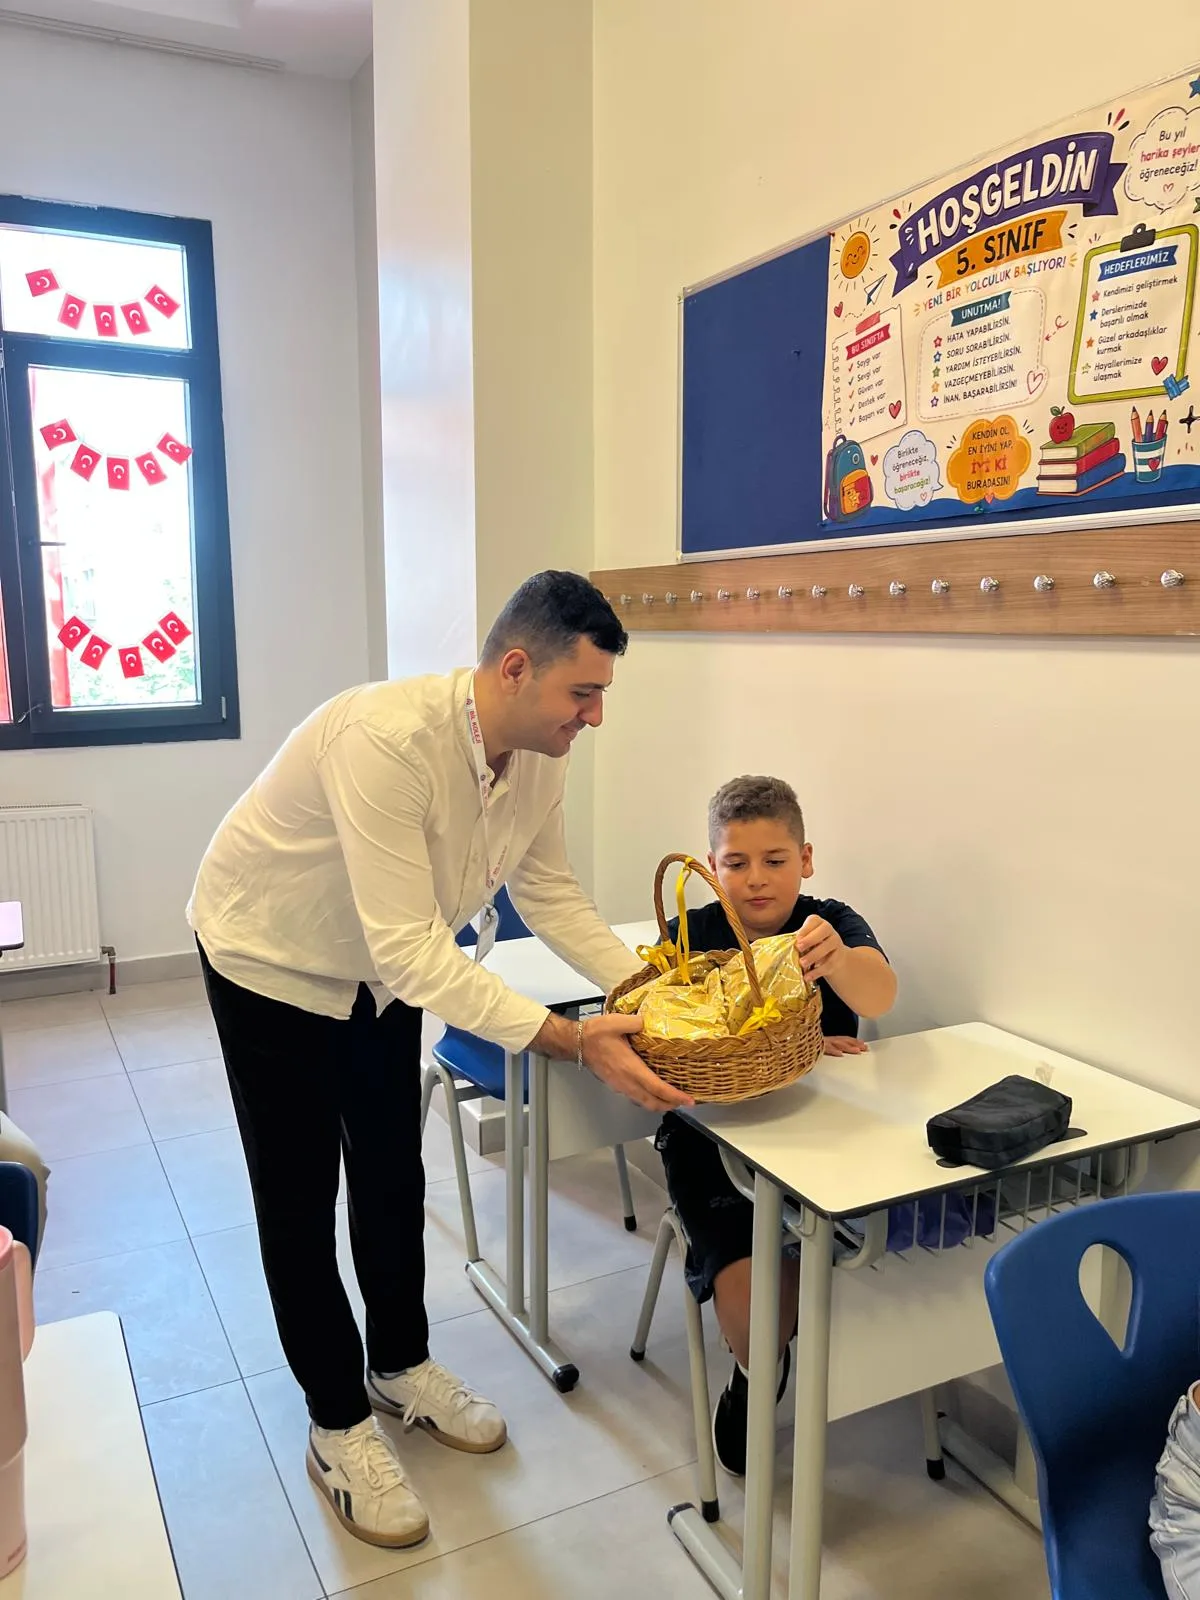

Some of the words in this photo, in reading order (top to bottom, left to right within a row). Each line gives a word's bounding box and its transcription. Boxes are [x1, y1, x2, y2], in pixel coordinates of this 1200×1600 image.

[1159, 130, 1171, 141] Bu
[1175, 126, 1187, 142] yıl
[1141, 148, 1169, 163] harika
[1172, 143, 1200, 158] şeyler
[1140, 159, 1198, 182] öğreneceğiz!
[917, 141, 1098, 254] HOŞGELDİN
[957, 247, 976, 275] 5.
[984, 218, 1047, 264] SINIF
[1104, 251, 1169, 275] HEDEFLERİMİZ
[922, 293, 943, 311] YENİ
[946, 286, 961, 302] BİR
[965, 268, 1011, 293] YOLCULUK
[1013, 256, 1067, 277] BAŞLIYOR!
[1103, 283, 1135, 297] Kendimizi
[1136, 275, 1178, 293] geliştirmek
[961, 299, 1001, 319] UNUTMA!
[1101, 300, 1147, 317] Derslerimizde
[1100, 315, 1124, 328] başarılı
[1127, 311, 1149, 323] olmak
[947, 332, 964, 343] HATA
[966, 316, 1010, 338] YAPABİLİRSİN.
[1098, 332, 1116, 345] Güzel
[1118, 326, 1168, 341] arkadaşlıklar
[851, 343, 859, 355] BU
[861, 331, 885, 349] SINIFTA
[1097, 343, 1122, 355] kurmak
[872, 352, 881, 360] var
[946, 361, 970, 373] YARDIM
[973, 346, 1022, 367] İSTEYEBİLİRSİN.
[947, 347, 964, 358] SORU
[873, 366, 881, 374] var
[1094, 357, 1142, 371] Hayallerimize
[875, 379, 884, 387] var
[944, 364, 1015, 388] VAZGEÇMEYEBİLİRSİN.
[1093, 371, 1122, 382] ulaşmak
[877, 392, 886, 401] var
[963, 379, 1018, 399] BAŞARABİLİRSİN!
[877, 407, 886, 415] var
[972, 427, 997, 440] KENDİN
[968, 446, 977, 455] EN
[967, 476, 1010, 490] BURADASIN!
